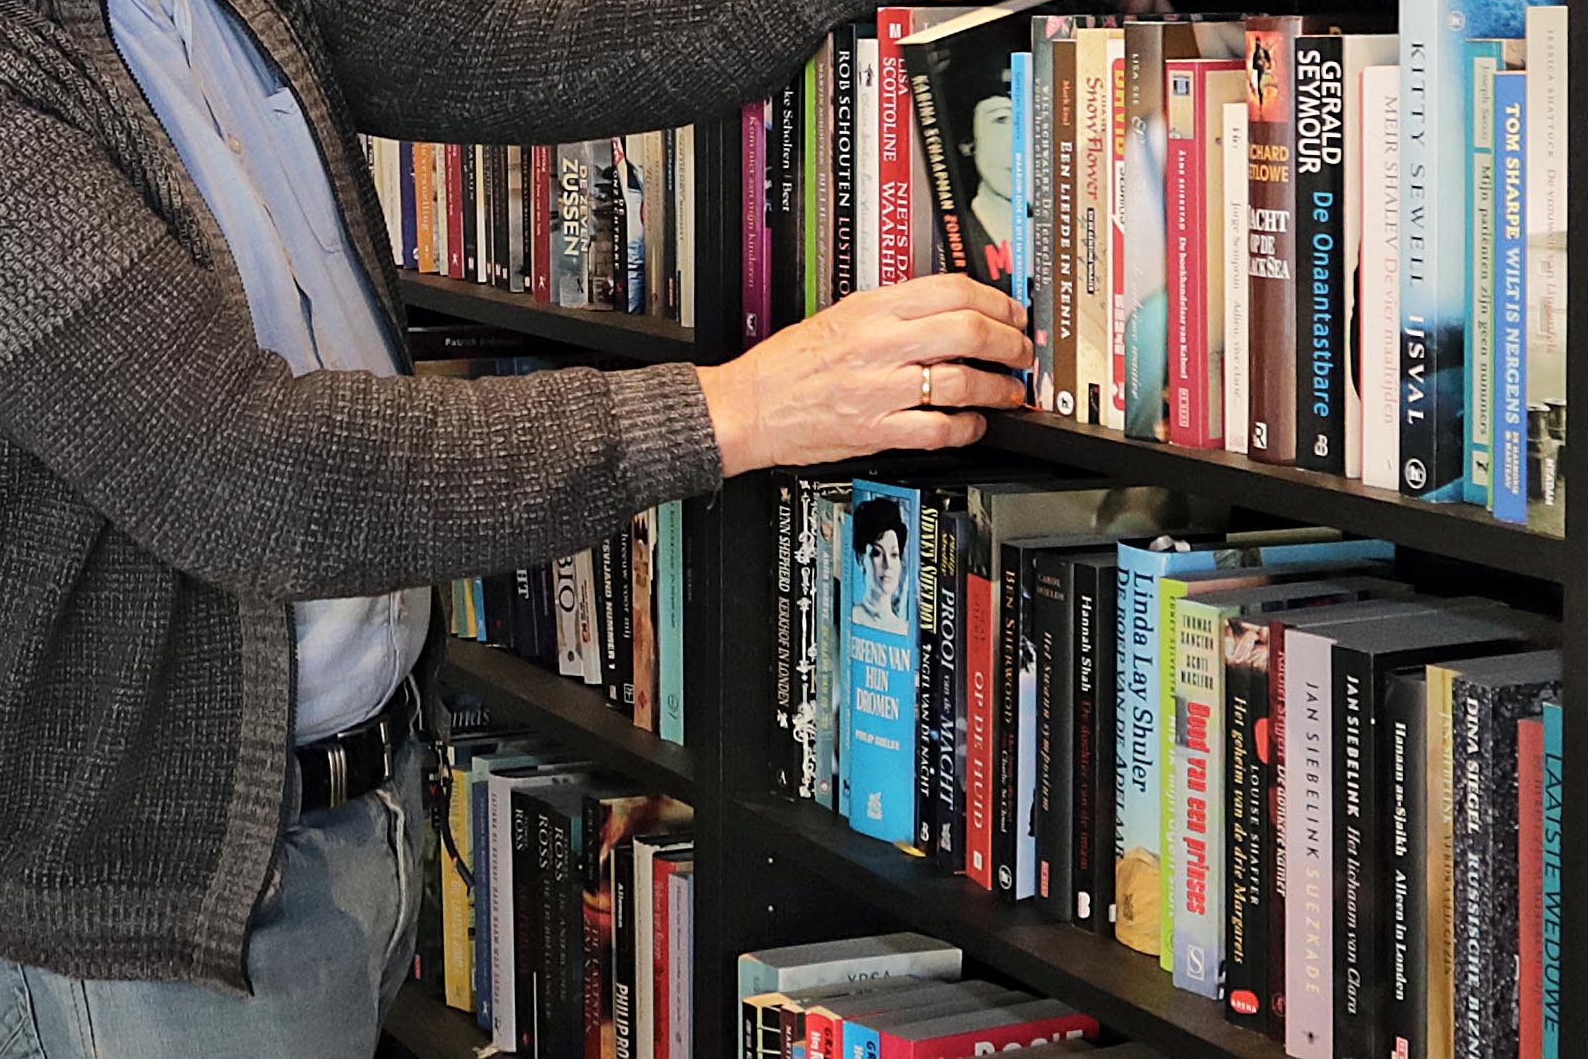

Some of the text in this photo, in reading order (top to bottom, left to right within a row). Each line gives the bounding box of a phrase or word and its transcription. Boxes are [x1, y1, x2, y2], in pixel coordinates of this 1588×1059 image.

[839, 51, 851, 207] ROB SCHOUTEN
[883, 57, 896, 161] SCOTTOLINE
[911, 76, 966, 267] KARINA SCHAAPMAN ZONDER
[1297, 50, 1321, 173] SEYMOUR
[1320, 62, 1341, 165] GERALD
[561, 158, 579, 256] ZUSSEN
[580, 165, 589, 252] DE ZEVEN
[897, 182, 908, 246] NIETS
[1060, 142, 1072, 339] EEN LIEFDE IN KENIA
[1381, 96, 1400, 424] MEIR SHALEV De vier maaltijden
[1404, 42, 1427, 426] KITTY SEWELL IJSVAL
[1477, 166, 1492, 435] Mijn patiënten zijn geen nummers
[1504, 103, 1521, 424] TOM SHARPE WILT IS NERGENS
[1311, 192, 1334, 417] De Onaantastbare
[777, 506, 790, 707] LYNN SHEPHERD KERKHOF IN LONDEN
[939, 589, 955, 810] PROOI van de MACHT
[1081, 596, 1091, 692] Hannah Shah
[1129, 571, 1154, 793] Linda Lay Shuler
[514, 809, 524, 851] ROSS
[538, 814, 548, 869] ROSS
[972, 672, 984, 828] OP DE HUID
[1183, 702, 1211, 916] Dood van een prinses
[1231, 696, 1246, 964] Het geheim van de drie Margarets
[1249, 765, 1259, 906] LOUISE SHAFFER
[1305, 682, 1320, 994] JAN SIEBELINK SUEZKADE
[1346, 676, 1361, 1015] JAN SIEBELINK Het lichaam van Clara
[554, 827, 563, 882] ROSS
[1544, 753, 1561, 1034] LAATSTE WEDUWE
[615, 984, 629, 1035] PHILIP
